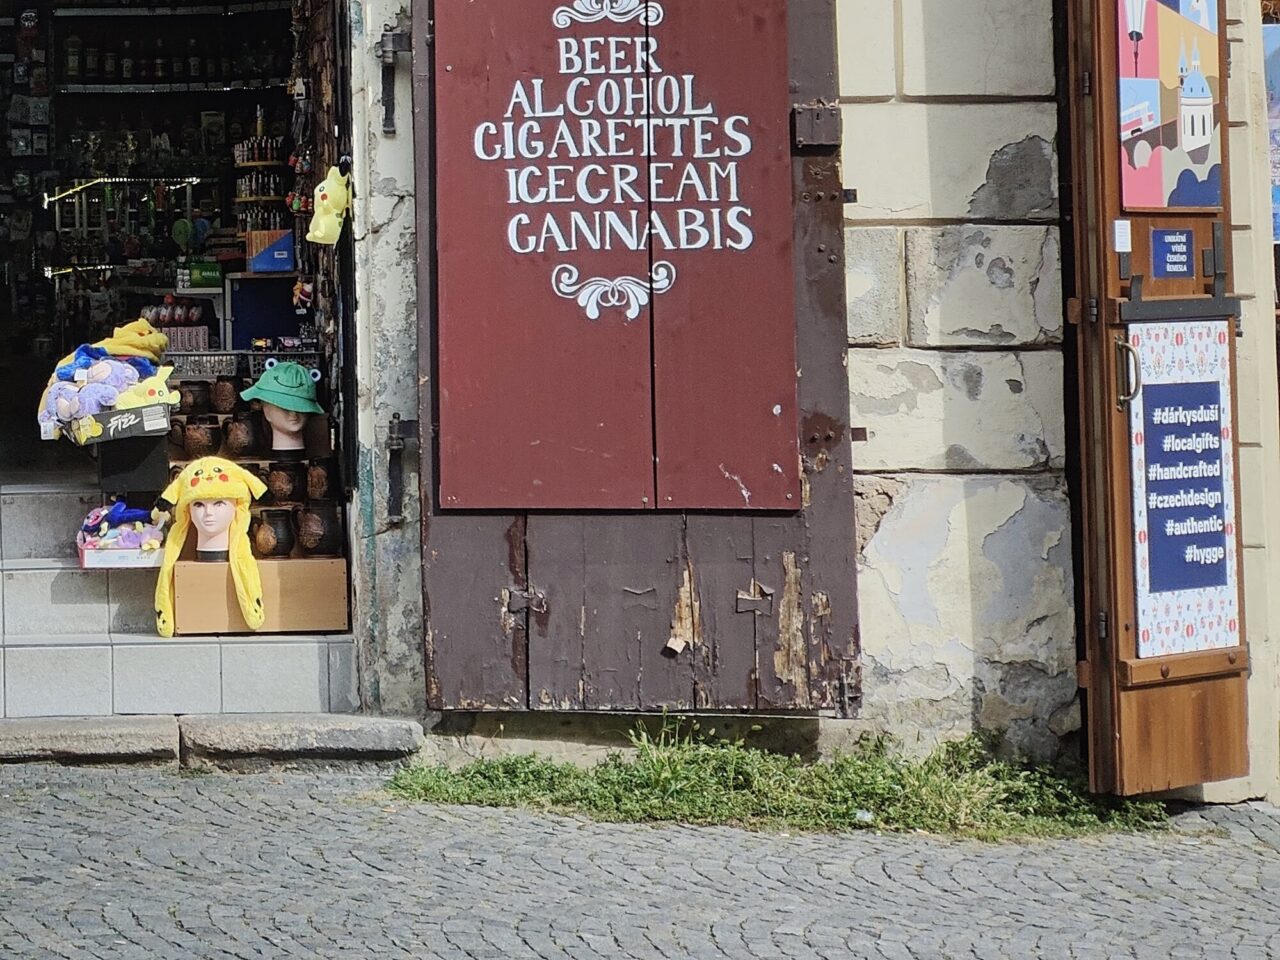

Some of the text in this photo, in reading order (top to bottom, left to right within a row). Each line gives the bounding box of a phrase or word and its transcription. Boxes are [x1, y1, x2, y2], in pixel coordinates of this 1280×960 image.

[558, 37, 662, 74] BEER
[504, 75, 712, 117] ALCOHOL
[474, 116, 751, 160] CIGARETTES
[506, 162, 738, 203] ICECREAM
[508, 206, 752, 253] CANNABIS
[1153, 404, 1219, 426] #dárkysduší
[1163, 433, 1220, 453] #localgifts
[1148, 460, 1220, 481] #handcrafted
[1148, 488, 1221, 509] #czechdesign
[1165, 515, 1223, 536] #authentic
[1185, 544, 1224, 565] #hygge
